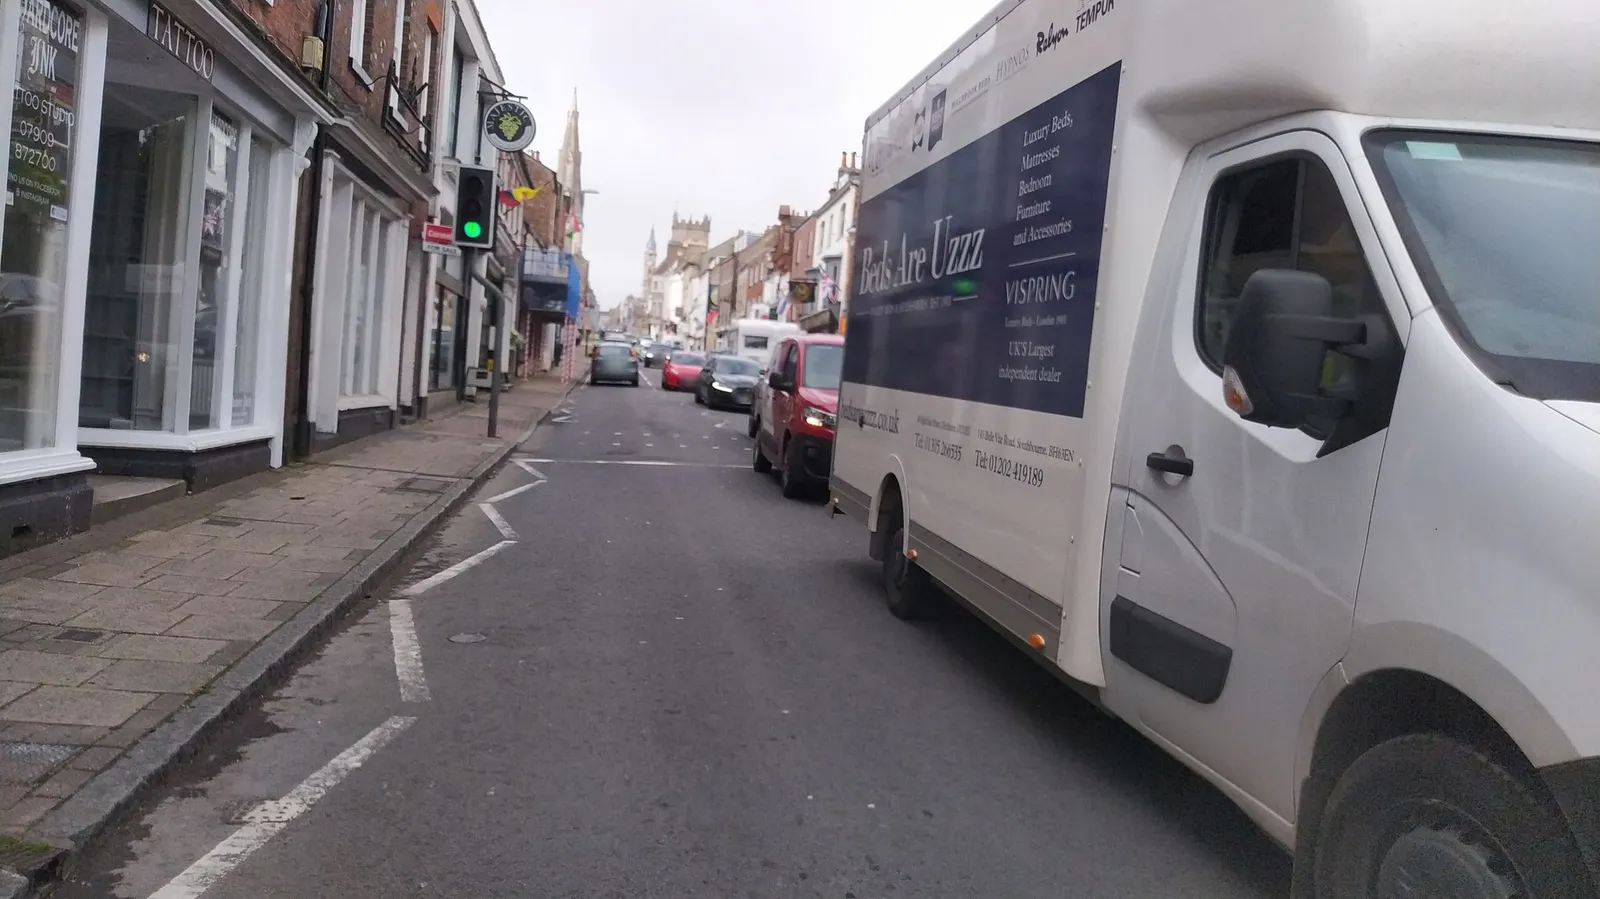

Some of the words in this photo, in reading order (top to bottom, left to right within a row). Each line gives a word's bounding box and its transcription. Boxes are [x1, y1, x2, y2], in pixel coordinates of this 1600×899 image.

[151, 4, 214, 79] TATTOO
[41, 99, 75, 127] STUDIO
[486, 103, 530, 130] MAJESTIC
[20, 120, 55, 148] 07909
[1023, 124, 1050, 148] Luxury
[1051, 110, 1074, 134] Beds,
[1020, 145, 1060, 172] Mattresses
[1018, 174, 1052, 197] Bedroom
[1016, 199, 1052, 221] Furniture
[1013, 227, 1028, 246] and
[1028, 216, 1073, 243] Accessories
[859, 239, 893, 295] Beds
[893, 232, 927, 288] Are
[931, 214, 985, 280] Uzzz
[1005, 270, 1075, 305] VISPRING
[1028, 341, 1054, 360] Largest
[998, 364, 1037, 382] independent
[1038, 365, 1061, 383] dealer
[975, 449, 988, 470] Tel:
[988, 454, 1011, 477] 01202
[1013, 461, 1044, 488] 419189
